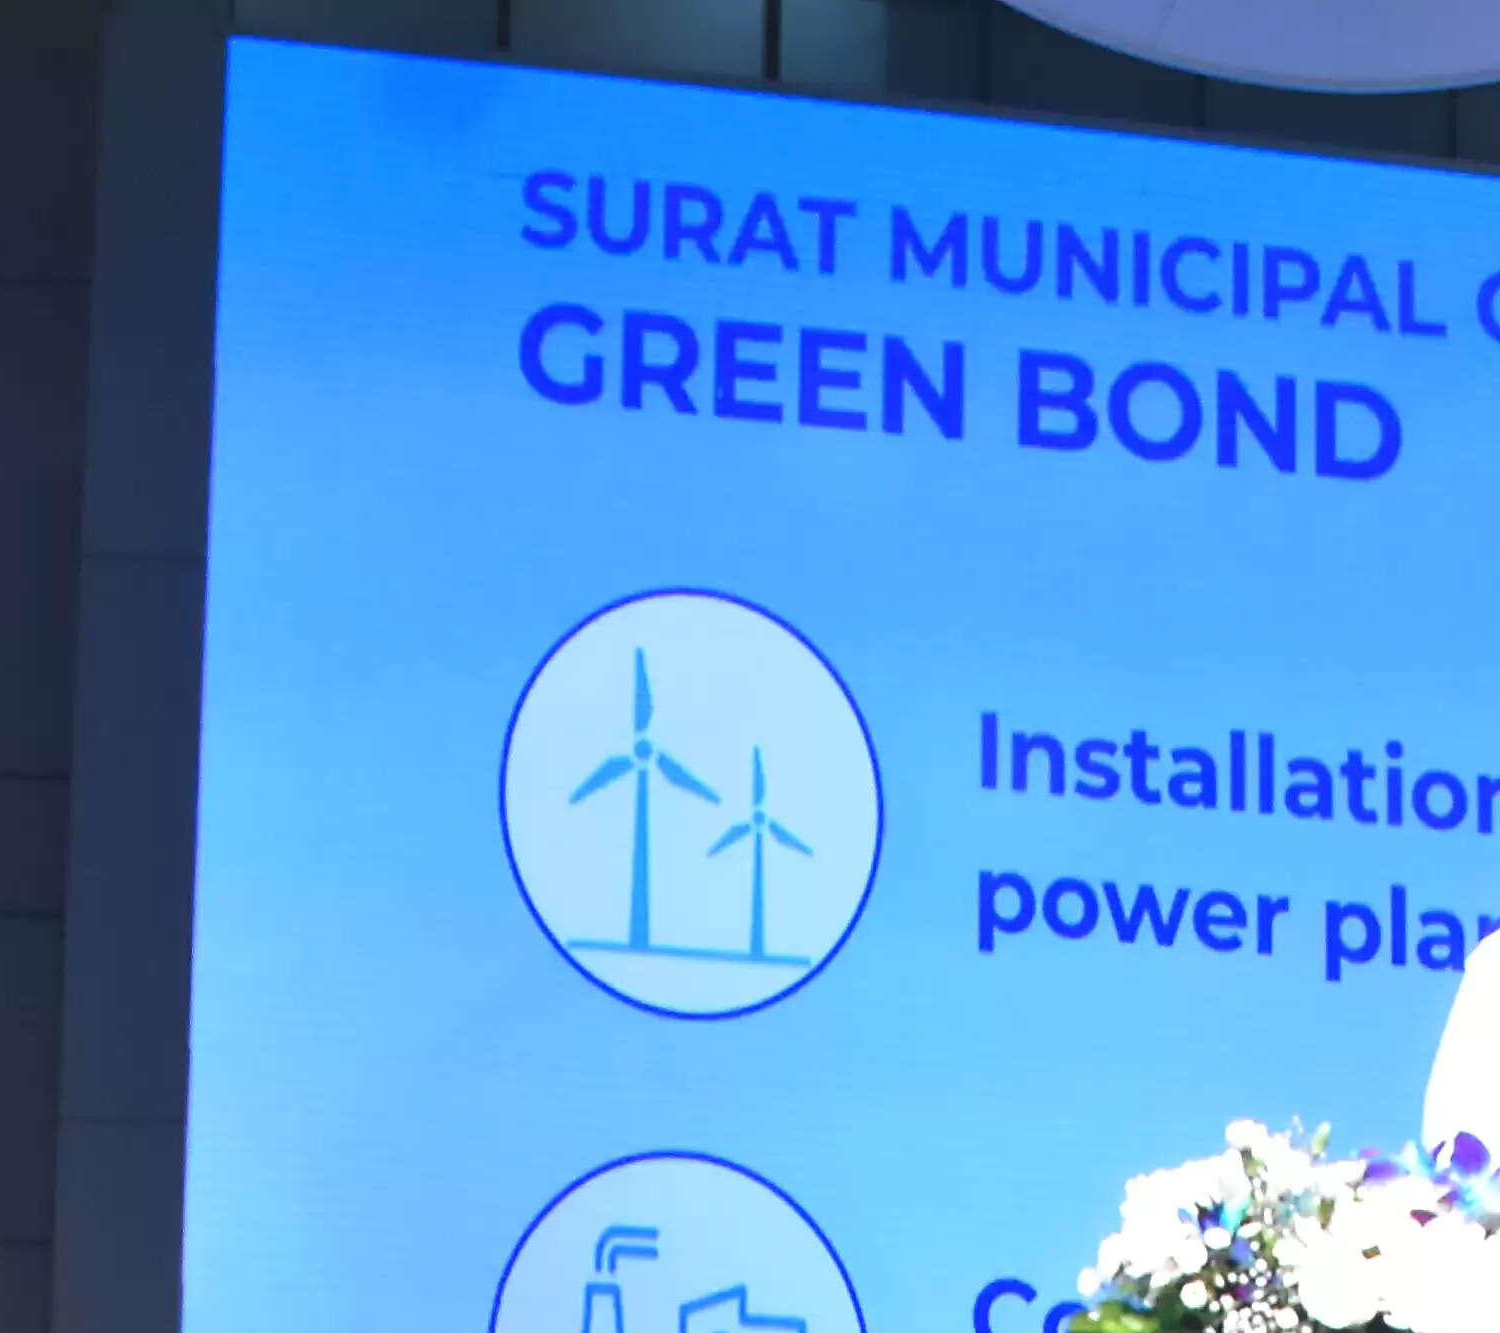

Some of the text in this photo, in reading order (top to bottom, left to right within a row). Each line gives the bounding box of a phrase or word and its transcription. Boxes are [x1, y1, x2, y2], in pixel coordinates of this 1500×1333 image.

[520, 169, 858, 275] SURAT
[890, 203, 1447, 338] MUNICIPAL
[518, 301, 1404, 482] GREEN BOND
[977, 868, 1289, 956] power
